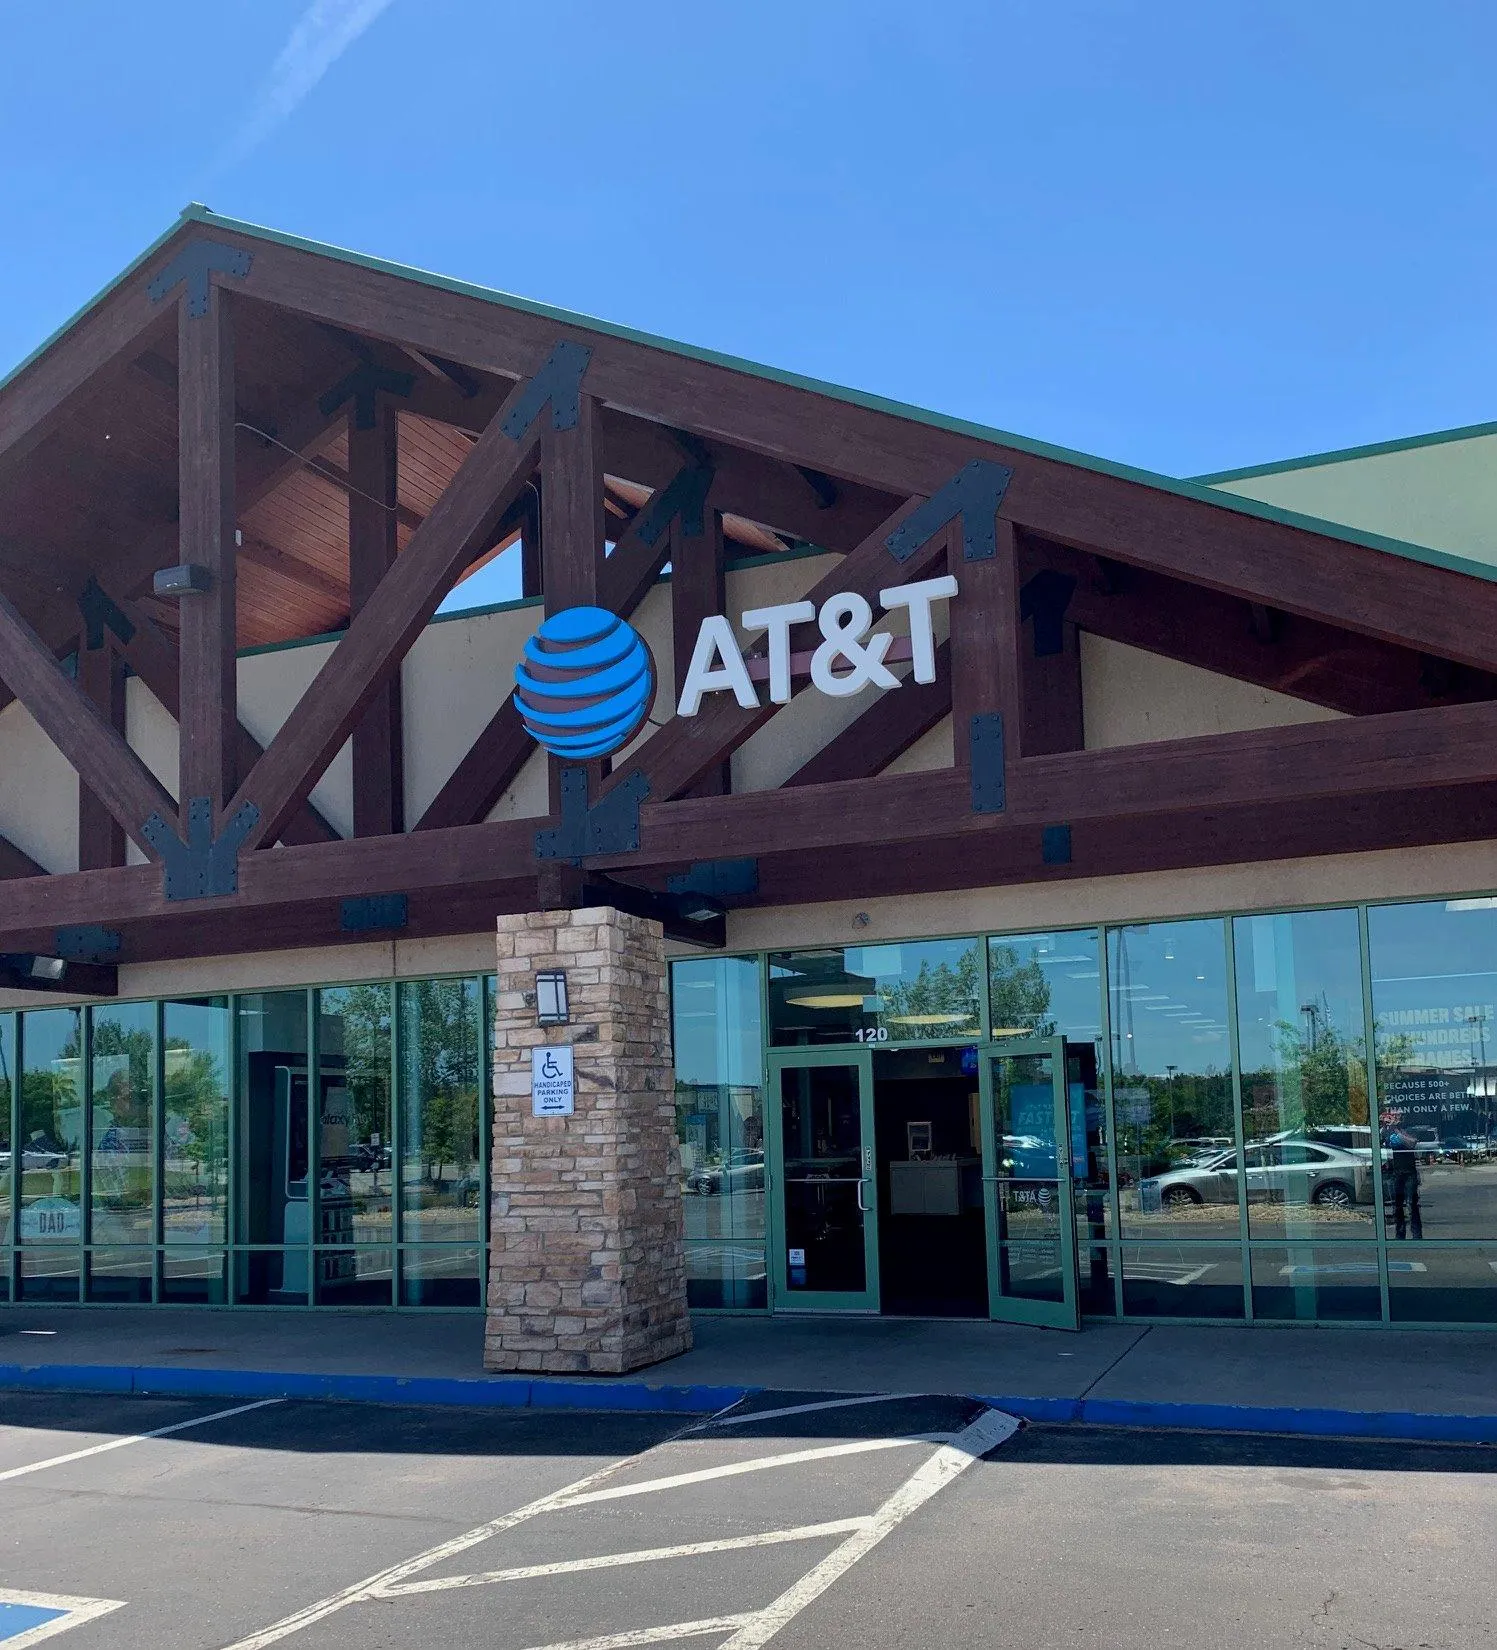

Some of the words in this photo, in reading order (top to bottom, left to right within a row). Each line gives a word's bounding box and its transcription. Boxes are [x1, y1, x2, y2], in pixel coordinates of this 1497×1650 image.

[677, 575, 958, 717] AT&T
[1379, 1008, 1450, 1025] SUMMER
[1453, 1004, 1495, 1023] SALE
[855, 1027, 888, 1042] 120
[1384, 1080, 1426, 1090] BECAUSE
[1428, 1080, 1450, 1088] 500+
[537, 1088, 569, 1096] PARKING
[1384, 1093, 1426, 1103] CHOICES
[1428, 1092, 1447, 1100] ARE
[543, 1096, 563, 1104] ONLY
[1385, 1105, 1411, 1114] THAN
[1412, 1105, 1438, 1113] ONLY
[1440, 1104, 1448, 1112] A
[1449, 1103, 1473, 1112] FEW.
[39, 1212, 64, 1234] DAD
